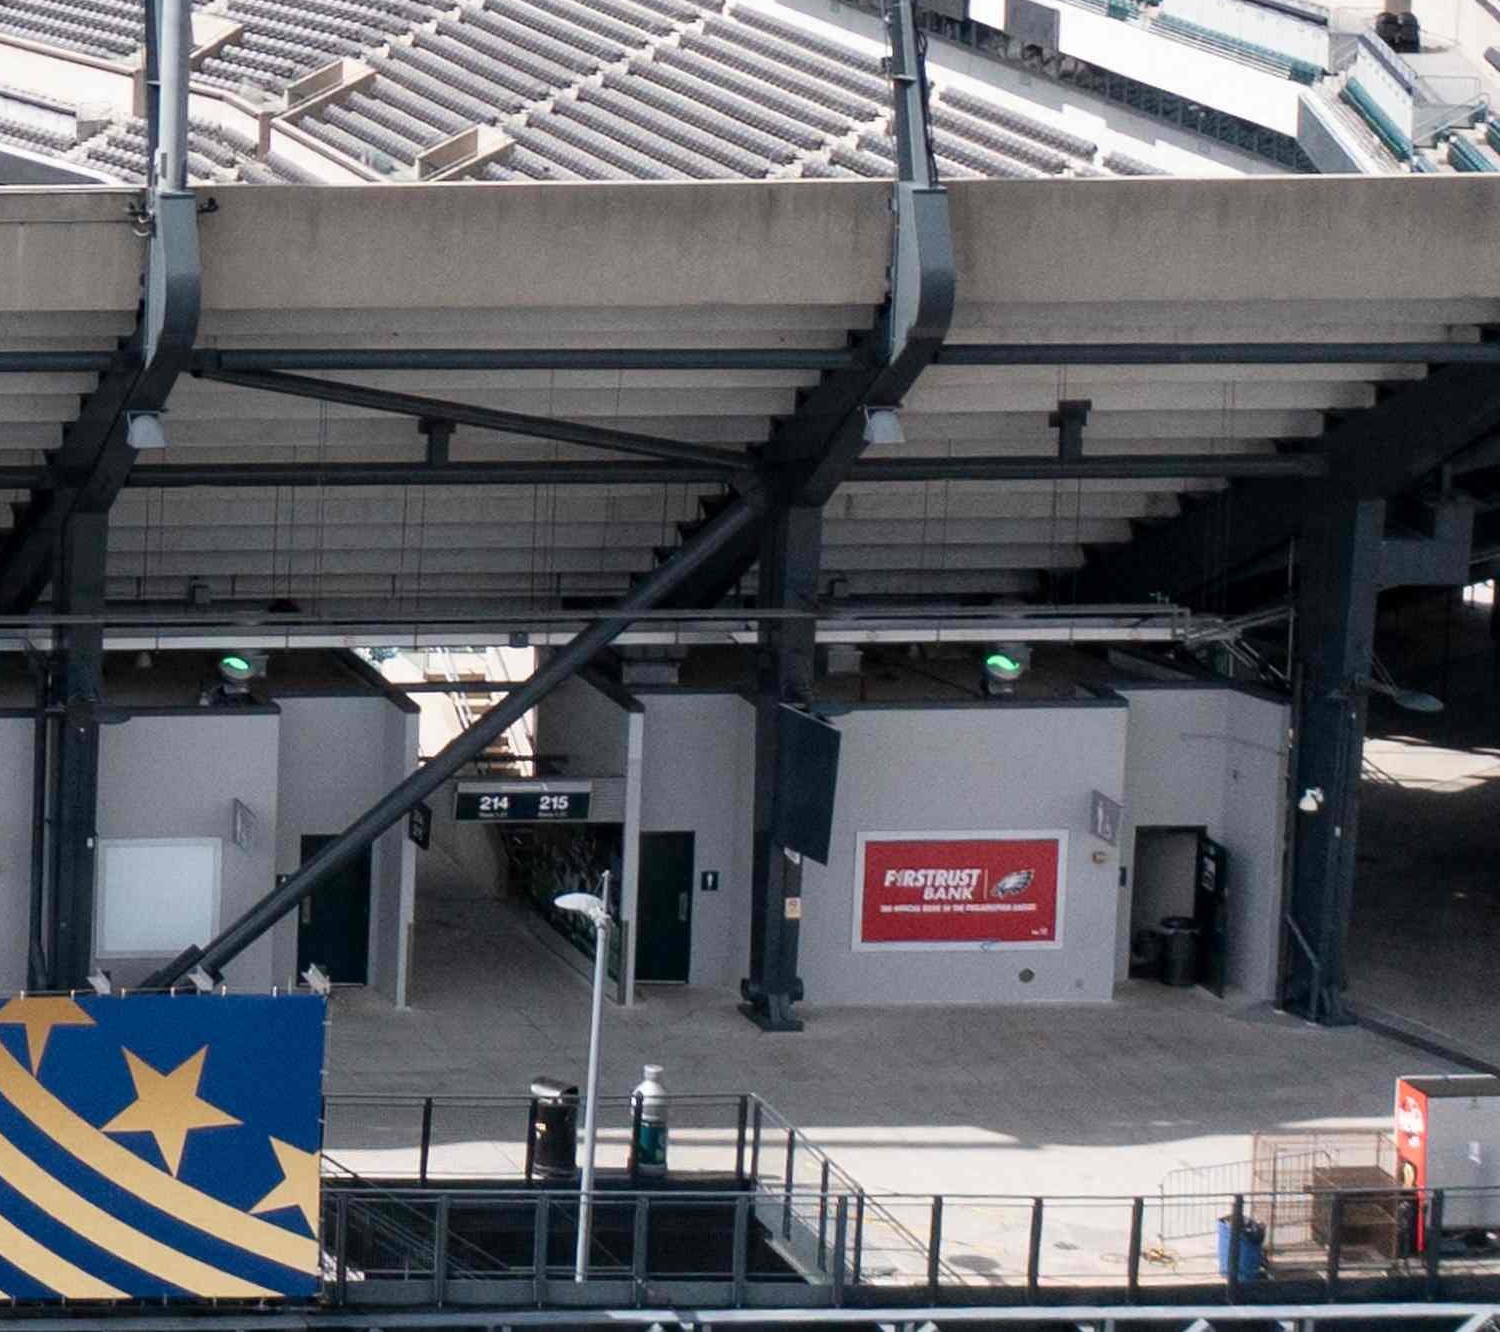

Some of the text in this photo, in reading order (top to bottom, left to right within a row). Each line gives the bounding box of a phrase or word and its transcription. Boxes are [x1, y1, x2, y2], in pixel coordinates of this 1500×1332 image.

[479, 795, 570, 811] 214 215
[923, 887, 975, 900] BANK
